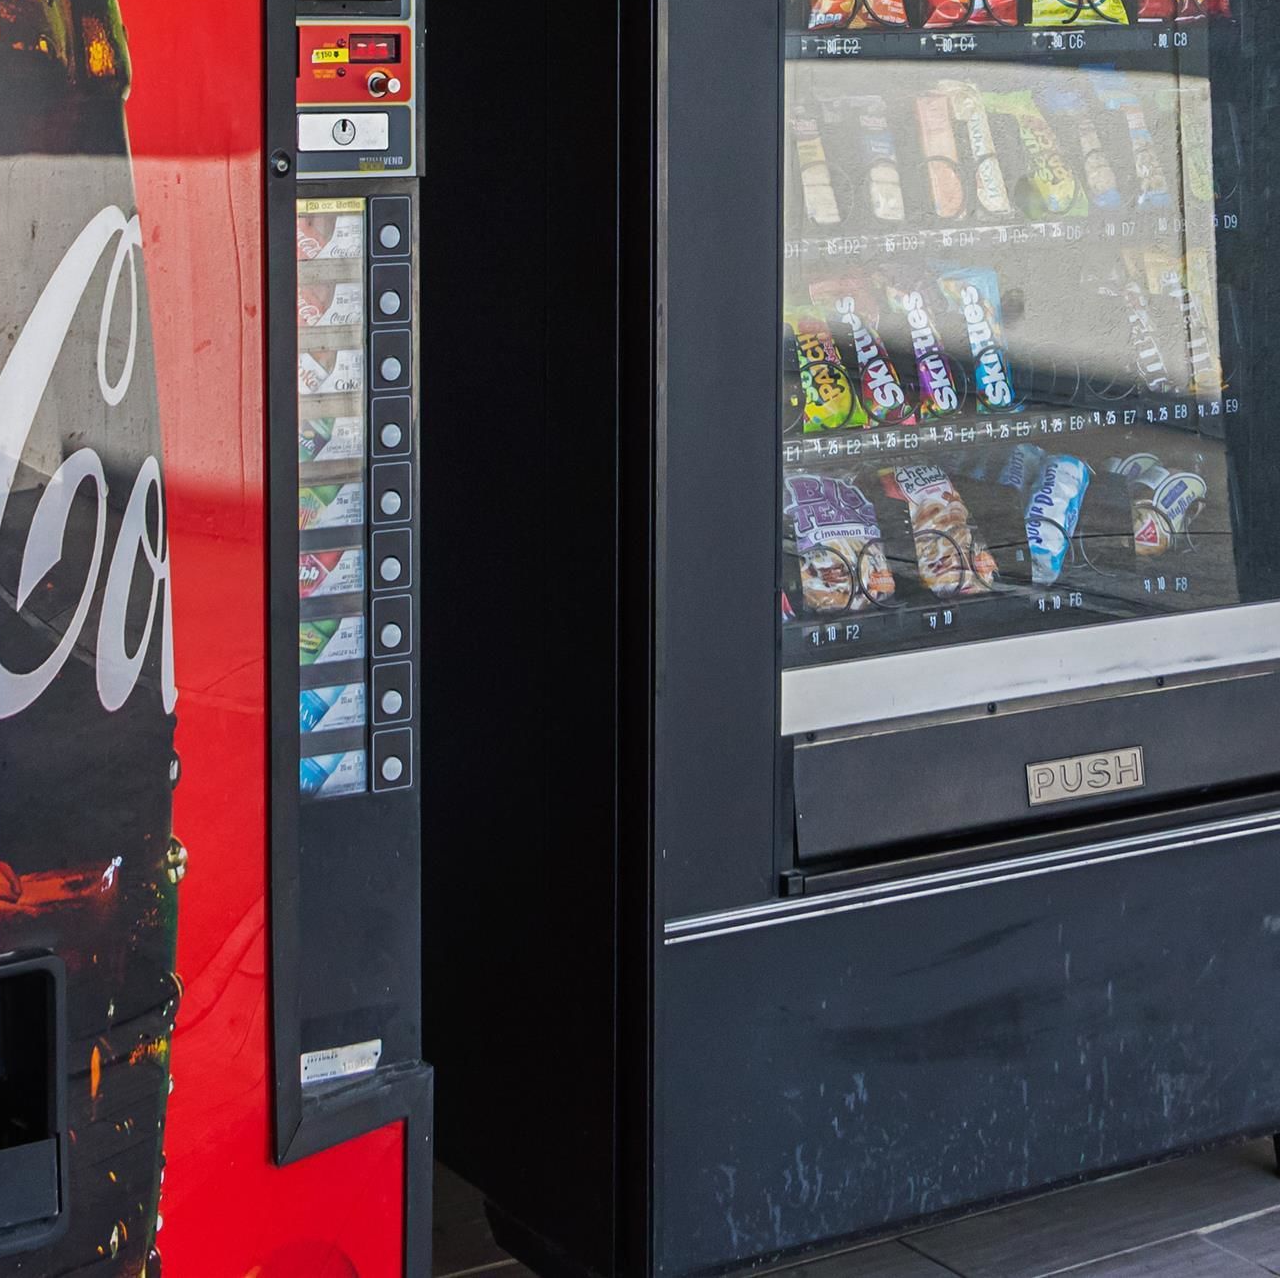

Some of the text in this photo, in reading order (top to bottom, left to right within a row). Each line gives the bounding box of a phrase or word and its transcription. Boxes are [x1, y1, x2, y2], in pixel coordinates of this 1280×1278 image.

[1174, 33, 1187, 46] C8
[1224, 215, 1238, 229] D9
[788, 475, 867, 509] BIG
[814, 528, 861, 541] Cinnamon
[1176, 577, 1188, 590] F8
[1070, 593, 1083, 607] F6
[846, 624, 860, 640] F2
[1033, 753, 1139, 799] PUSH
